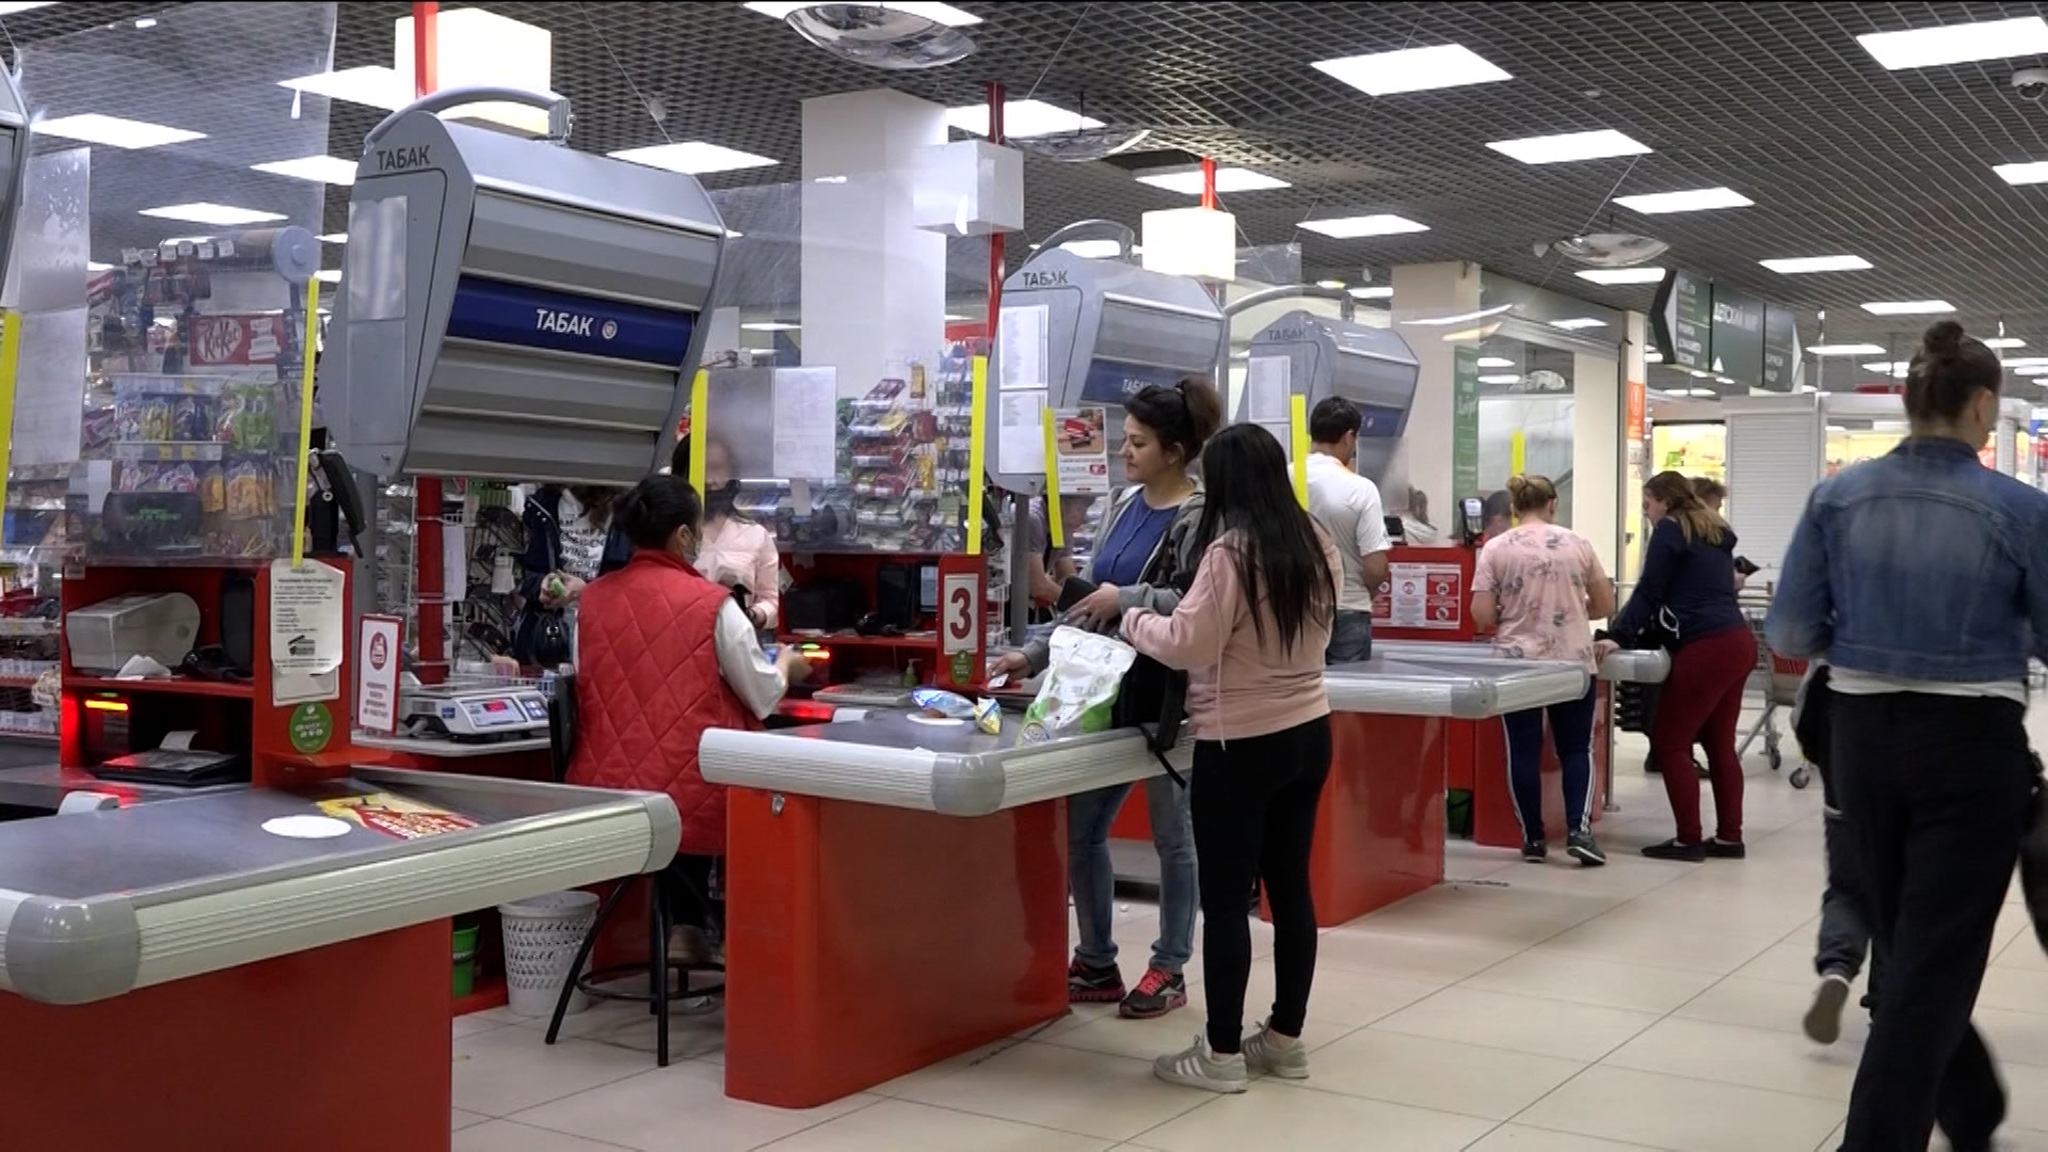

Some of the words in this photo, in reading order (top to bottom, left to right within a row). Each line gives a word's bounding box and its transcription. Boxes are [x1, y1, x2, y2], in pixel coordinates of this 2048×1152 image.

[377, 144, 430, 171] ТАБАК
[1022, 270, 1068, 287] ТАБАК
[536, 308, 593, 337] ТАБАК
[949, 587, 972, 640] 3
